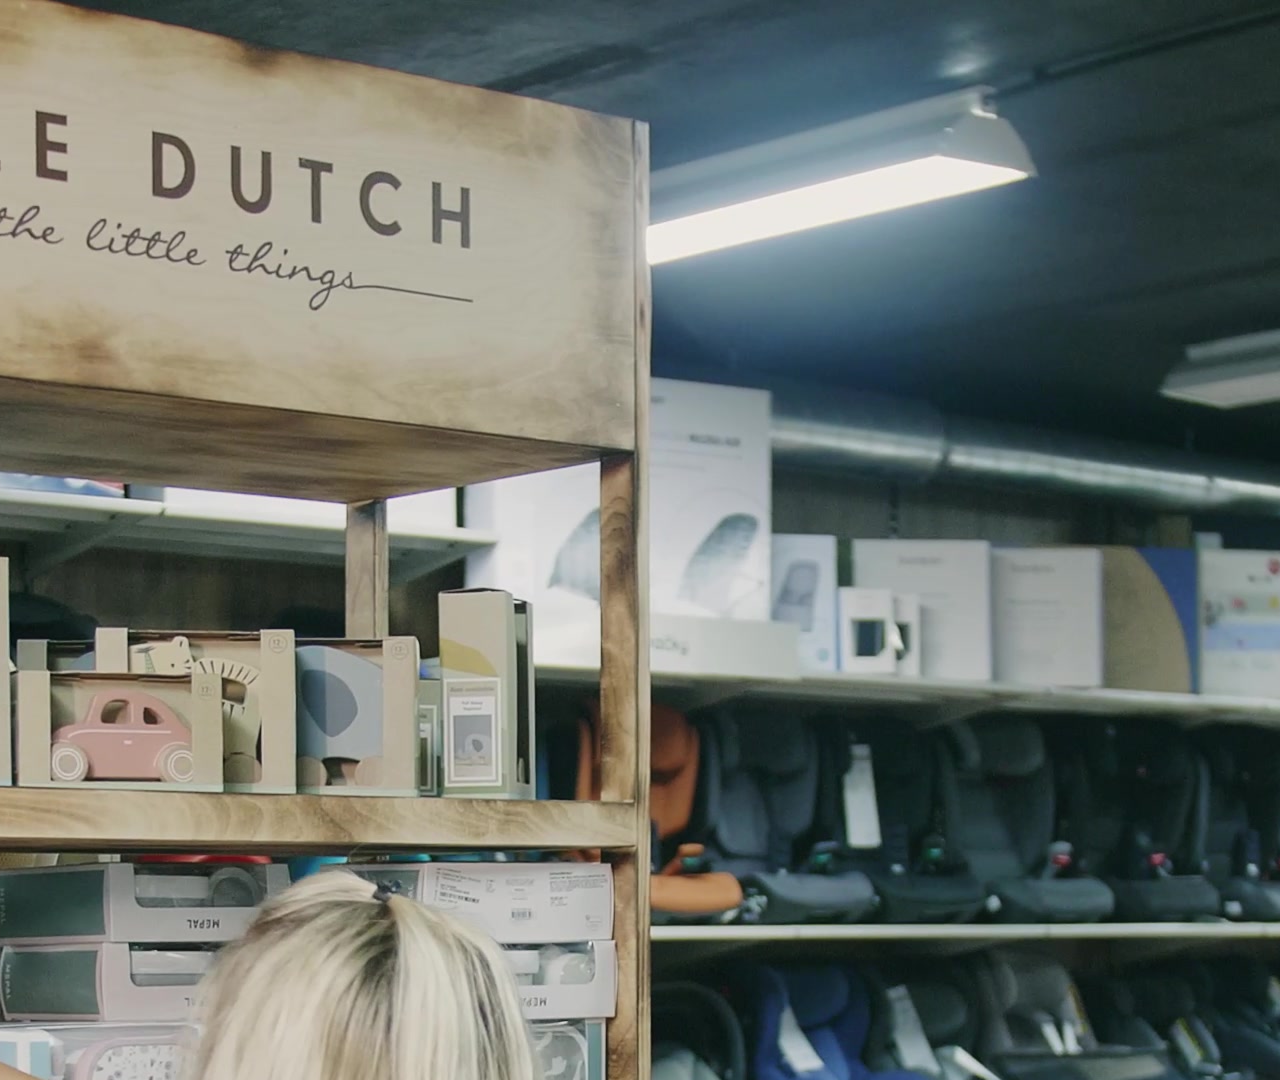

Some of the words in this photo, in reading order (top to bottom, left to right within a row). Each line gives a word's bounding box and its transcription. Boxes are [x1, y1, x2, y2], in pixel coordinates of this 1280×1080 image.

[152, 130, 472, 249] DUTCH
[86, 219, 207, 266] little
[225, 241, 356, 311] things
[186, 918, 220, 929] MEPAL
[520, 996, 548, 1008] MEP
